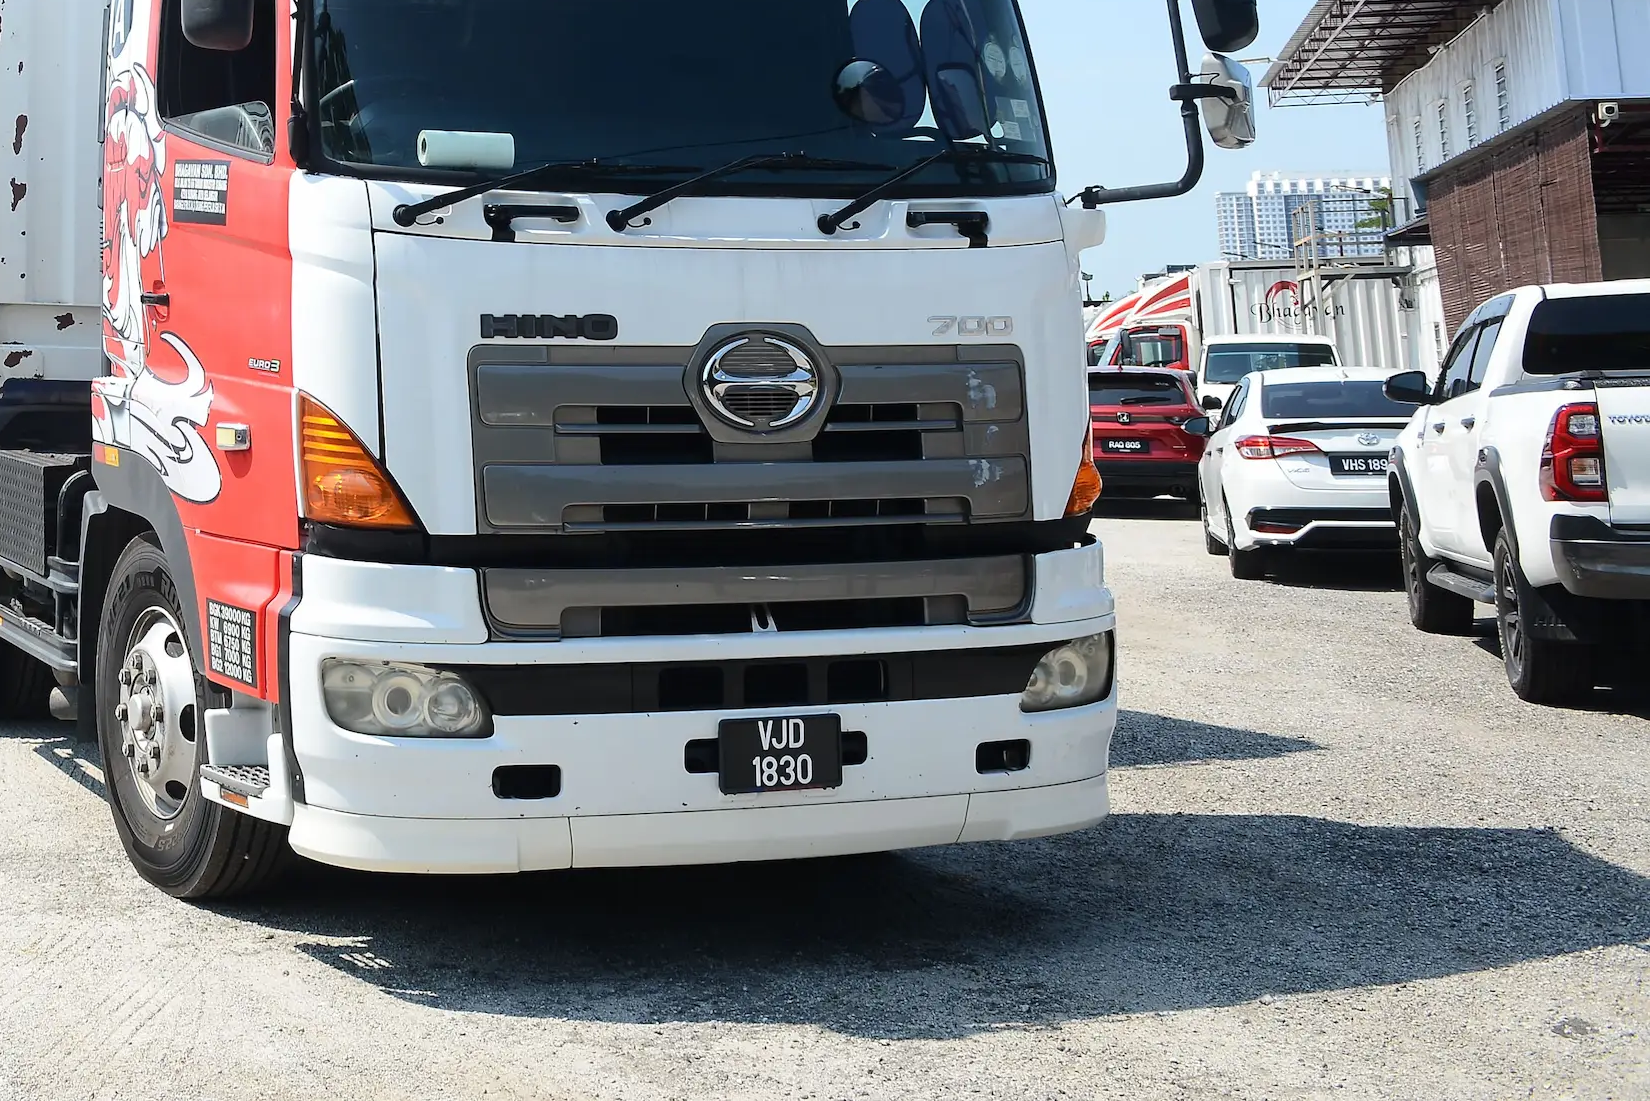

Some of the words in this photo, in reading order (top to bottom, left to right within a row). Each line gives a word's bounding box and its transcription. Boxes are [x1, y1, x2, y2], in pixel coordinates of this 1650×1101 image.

[480, 314, 618, 340] HINO
[927, 316, 1013, 336] 700
[1341, 458, 1366, 471] VHS
[220, 604, 242, 624] 39000
[241, 611, 251, 627] KG
[223, 620, 240, 638] 6900
[241, 625, 251, 641] KG
[223, 634, 240, 651] 6750
[241, 639, 251, 655] KG
[224, 647, 240, 665] 7000
[242, 653, 252, 669] KG
[224, 661, 243, 680] 12000
[242, 667, 253, 684] KG
[757, 718, 805, 751] VJD
[752, 754, 813, 787] 1830
